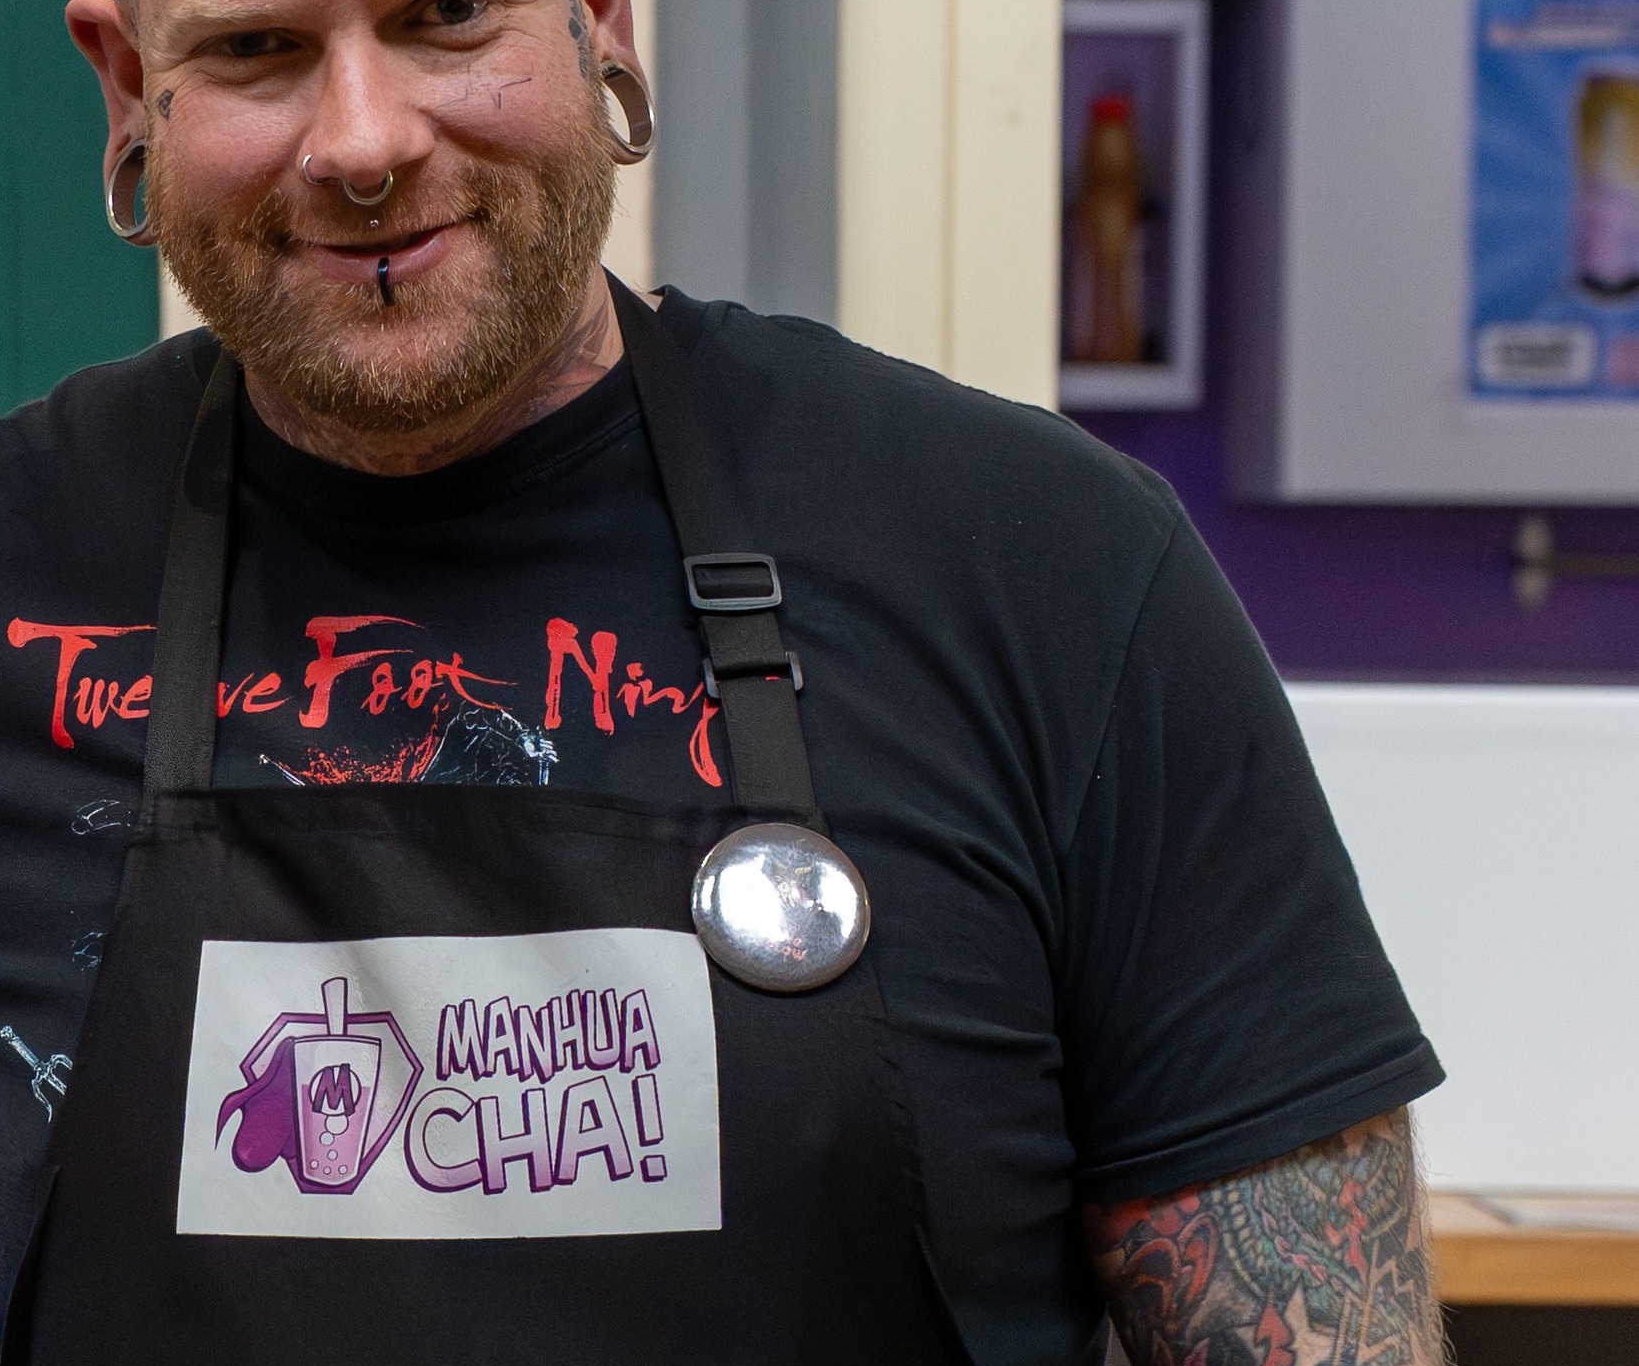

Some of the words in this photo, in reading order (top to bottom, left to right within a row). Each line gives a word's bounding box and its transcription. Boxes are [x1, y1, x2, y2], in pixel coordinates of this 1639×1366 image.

[7, 617, 289, 749] Tweve
[300, 615, 518, 729] Foot
[545, 617, 723, 788] Ninj
[436, 988, 661, 1085] MANHUA
[403, 1073, 667, 1195] CHA!
